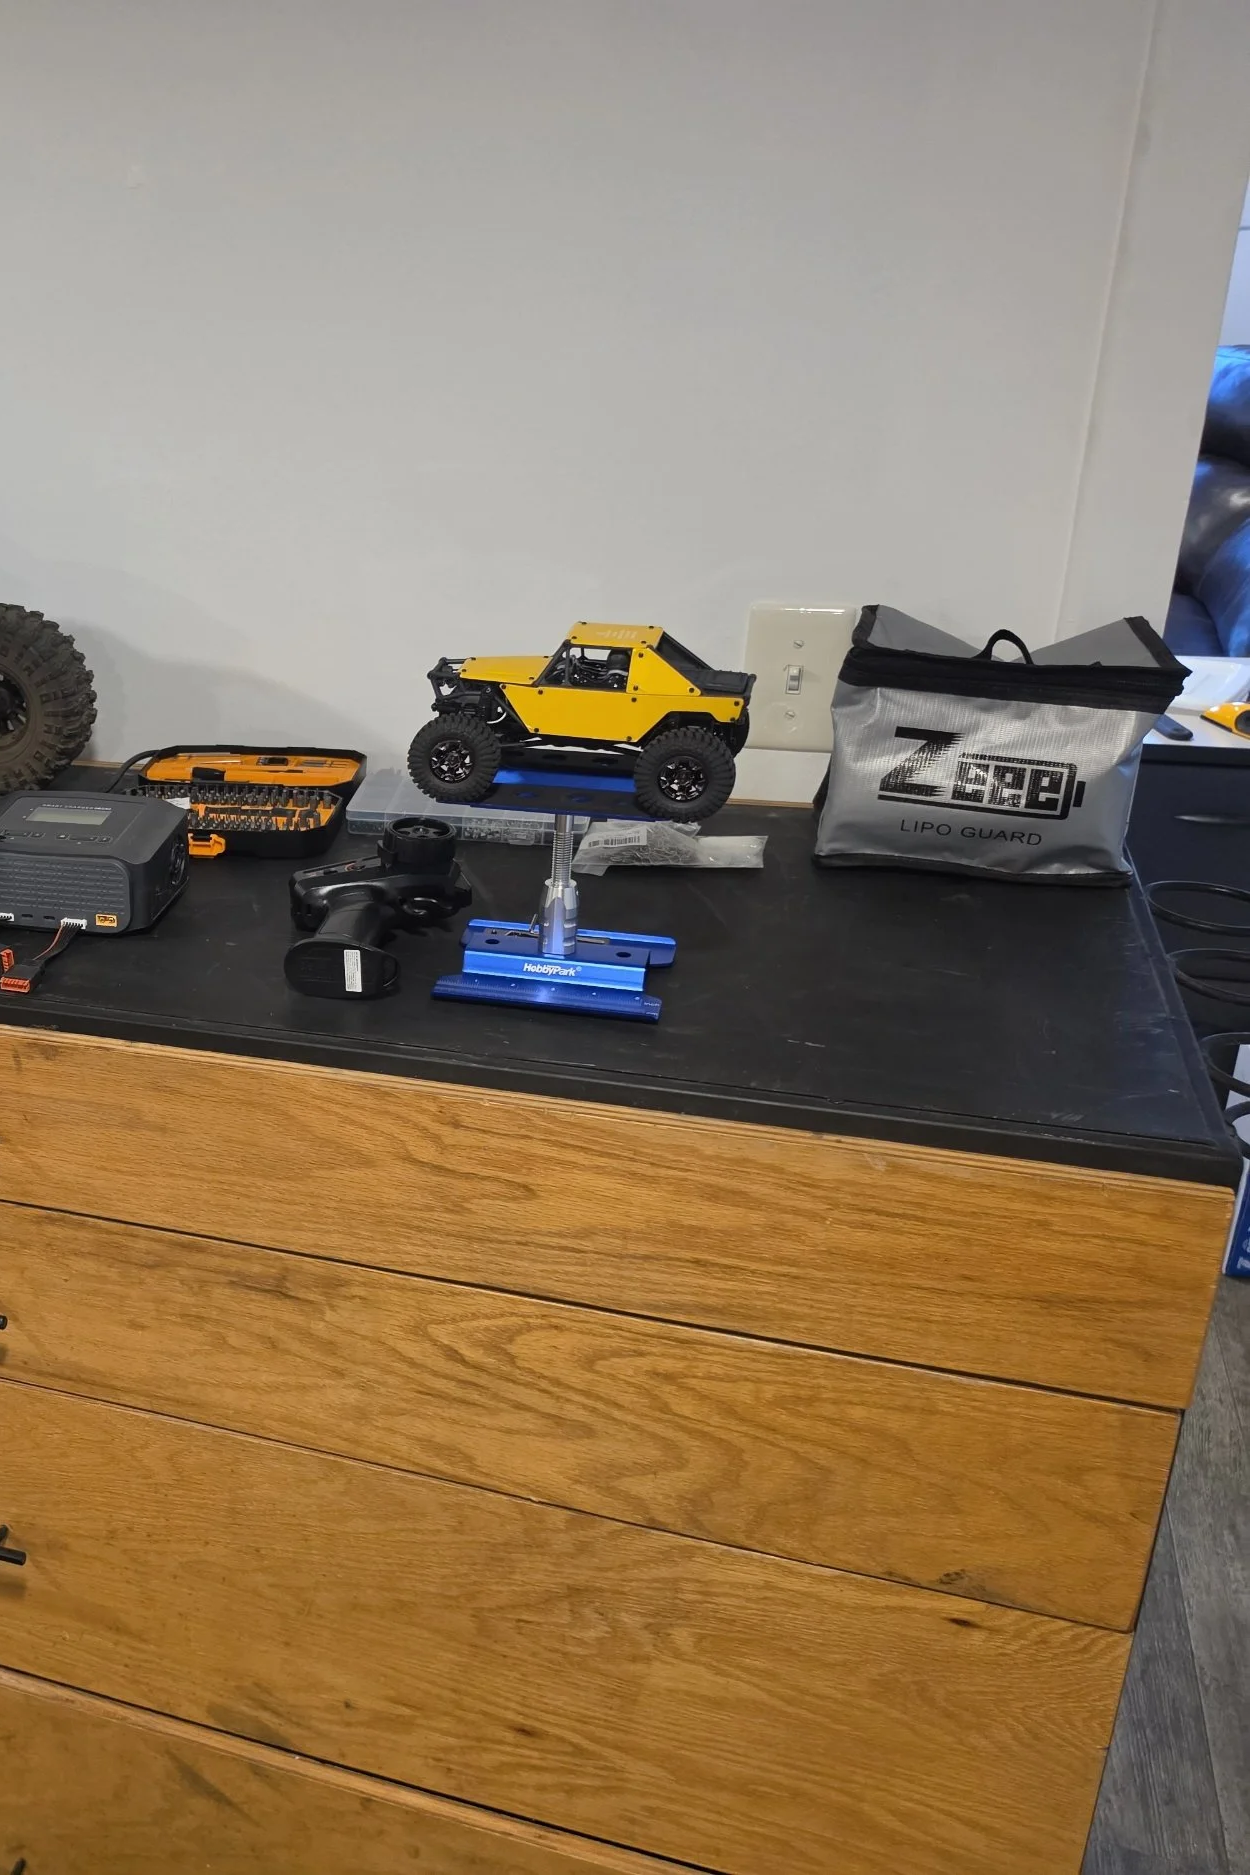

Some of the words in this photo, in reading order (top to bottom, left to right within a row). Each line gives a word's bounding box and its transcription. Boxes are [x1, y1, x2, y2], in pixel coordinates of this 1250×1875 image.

[900, 819, 952, 837] LIPO
[960, 826, 1043, 846] GUARD
[522, 962, 576, 977] HobbyPark
